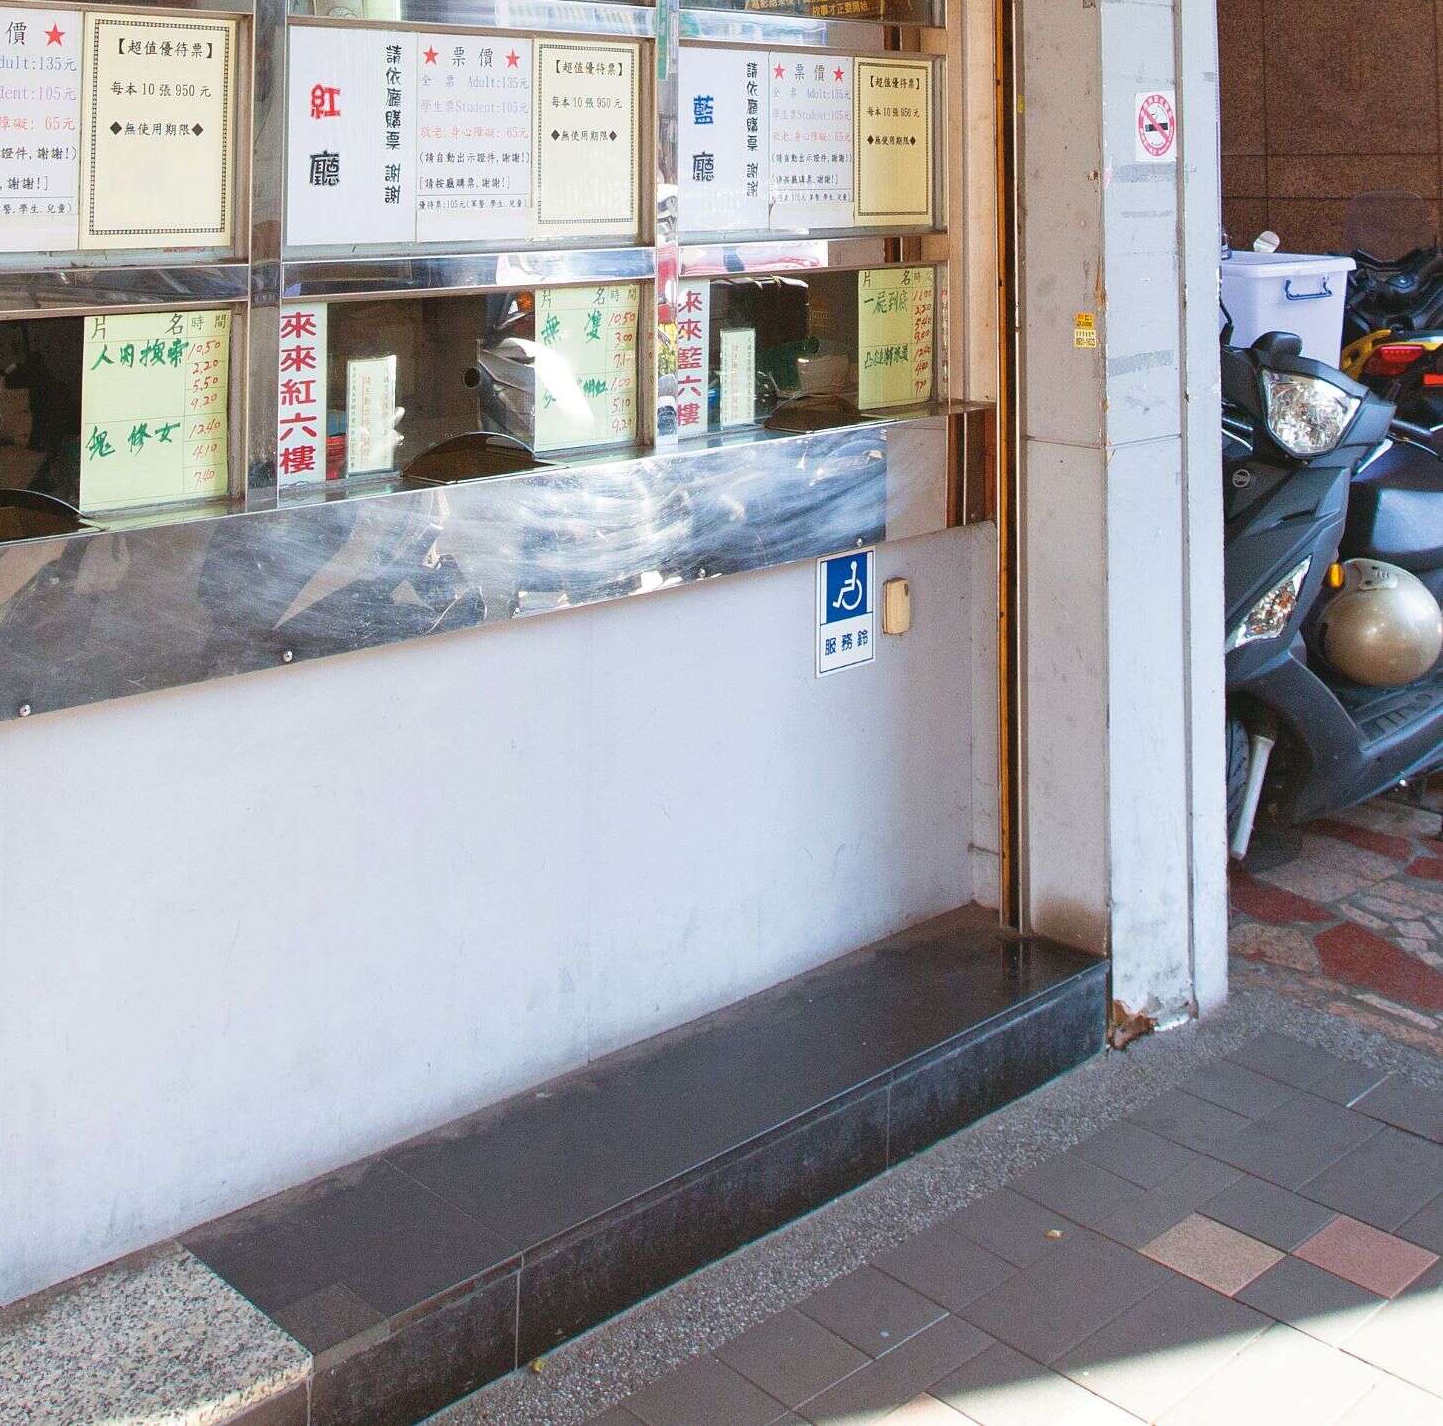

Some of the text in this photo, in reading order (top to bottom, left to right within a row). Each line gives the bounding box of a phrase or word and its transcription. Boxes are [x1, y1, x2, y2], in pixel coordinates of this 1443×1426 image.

[452, 47, 494, 68] 票價
[310, 84, 341, 187] 紅廳
[279, 311, 317, 475] 來來紅六樓
